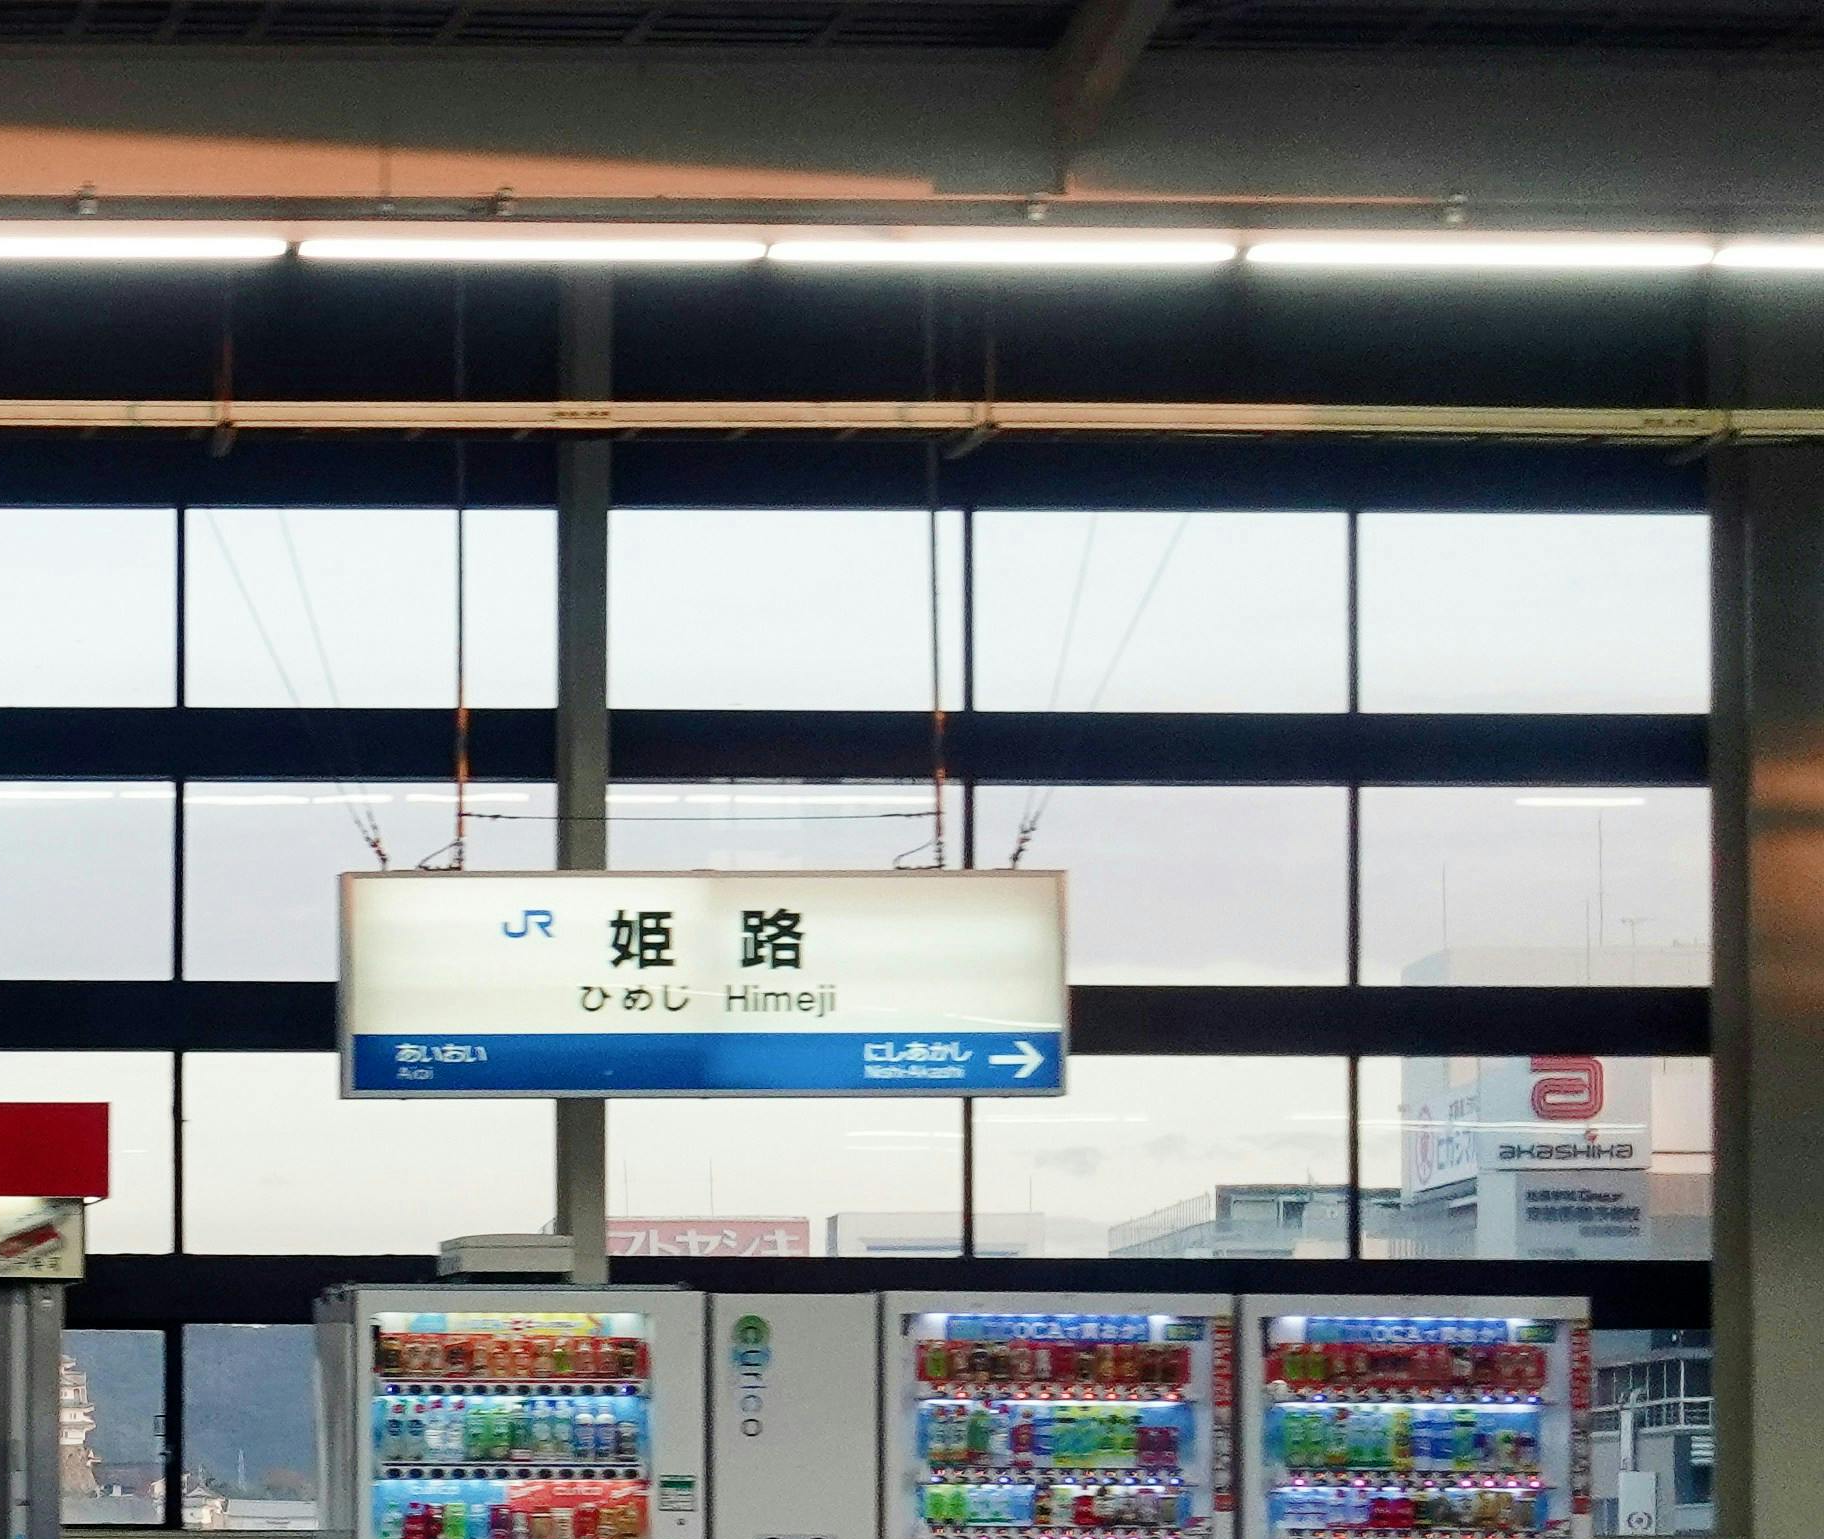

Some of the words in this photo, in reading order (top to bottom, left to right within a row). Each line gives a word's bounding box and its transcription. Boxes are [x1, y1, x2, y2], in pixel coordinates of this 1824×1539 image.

[501, 909, 555, 939] JR
[609, 908, 805, 970] 姫路
[579, 984, 690, 1013] ひめじ
[725, 984, 836, 1015] Himeji
